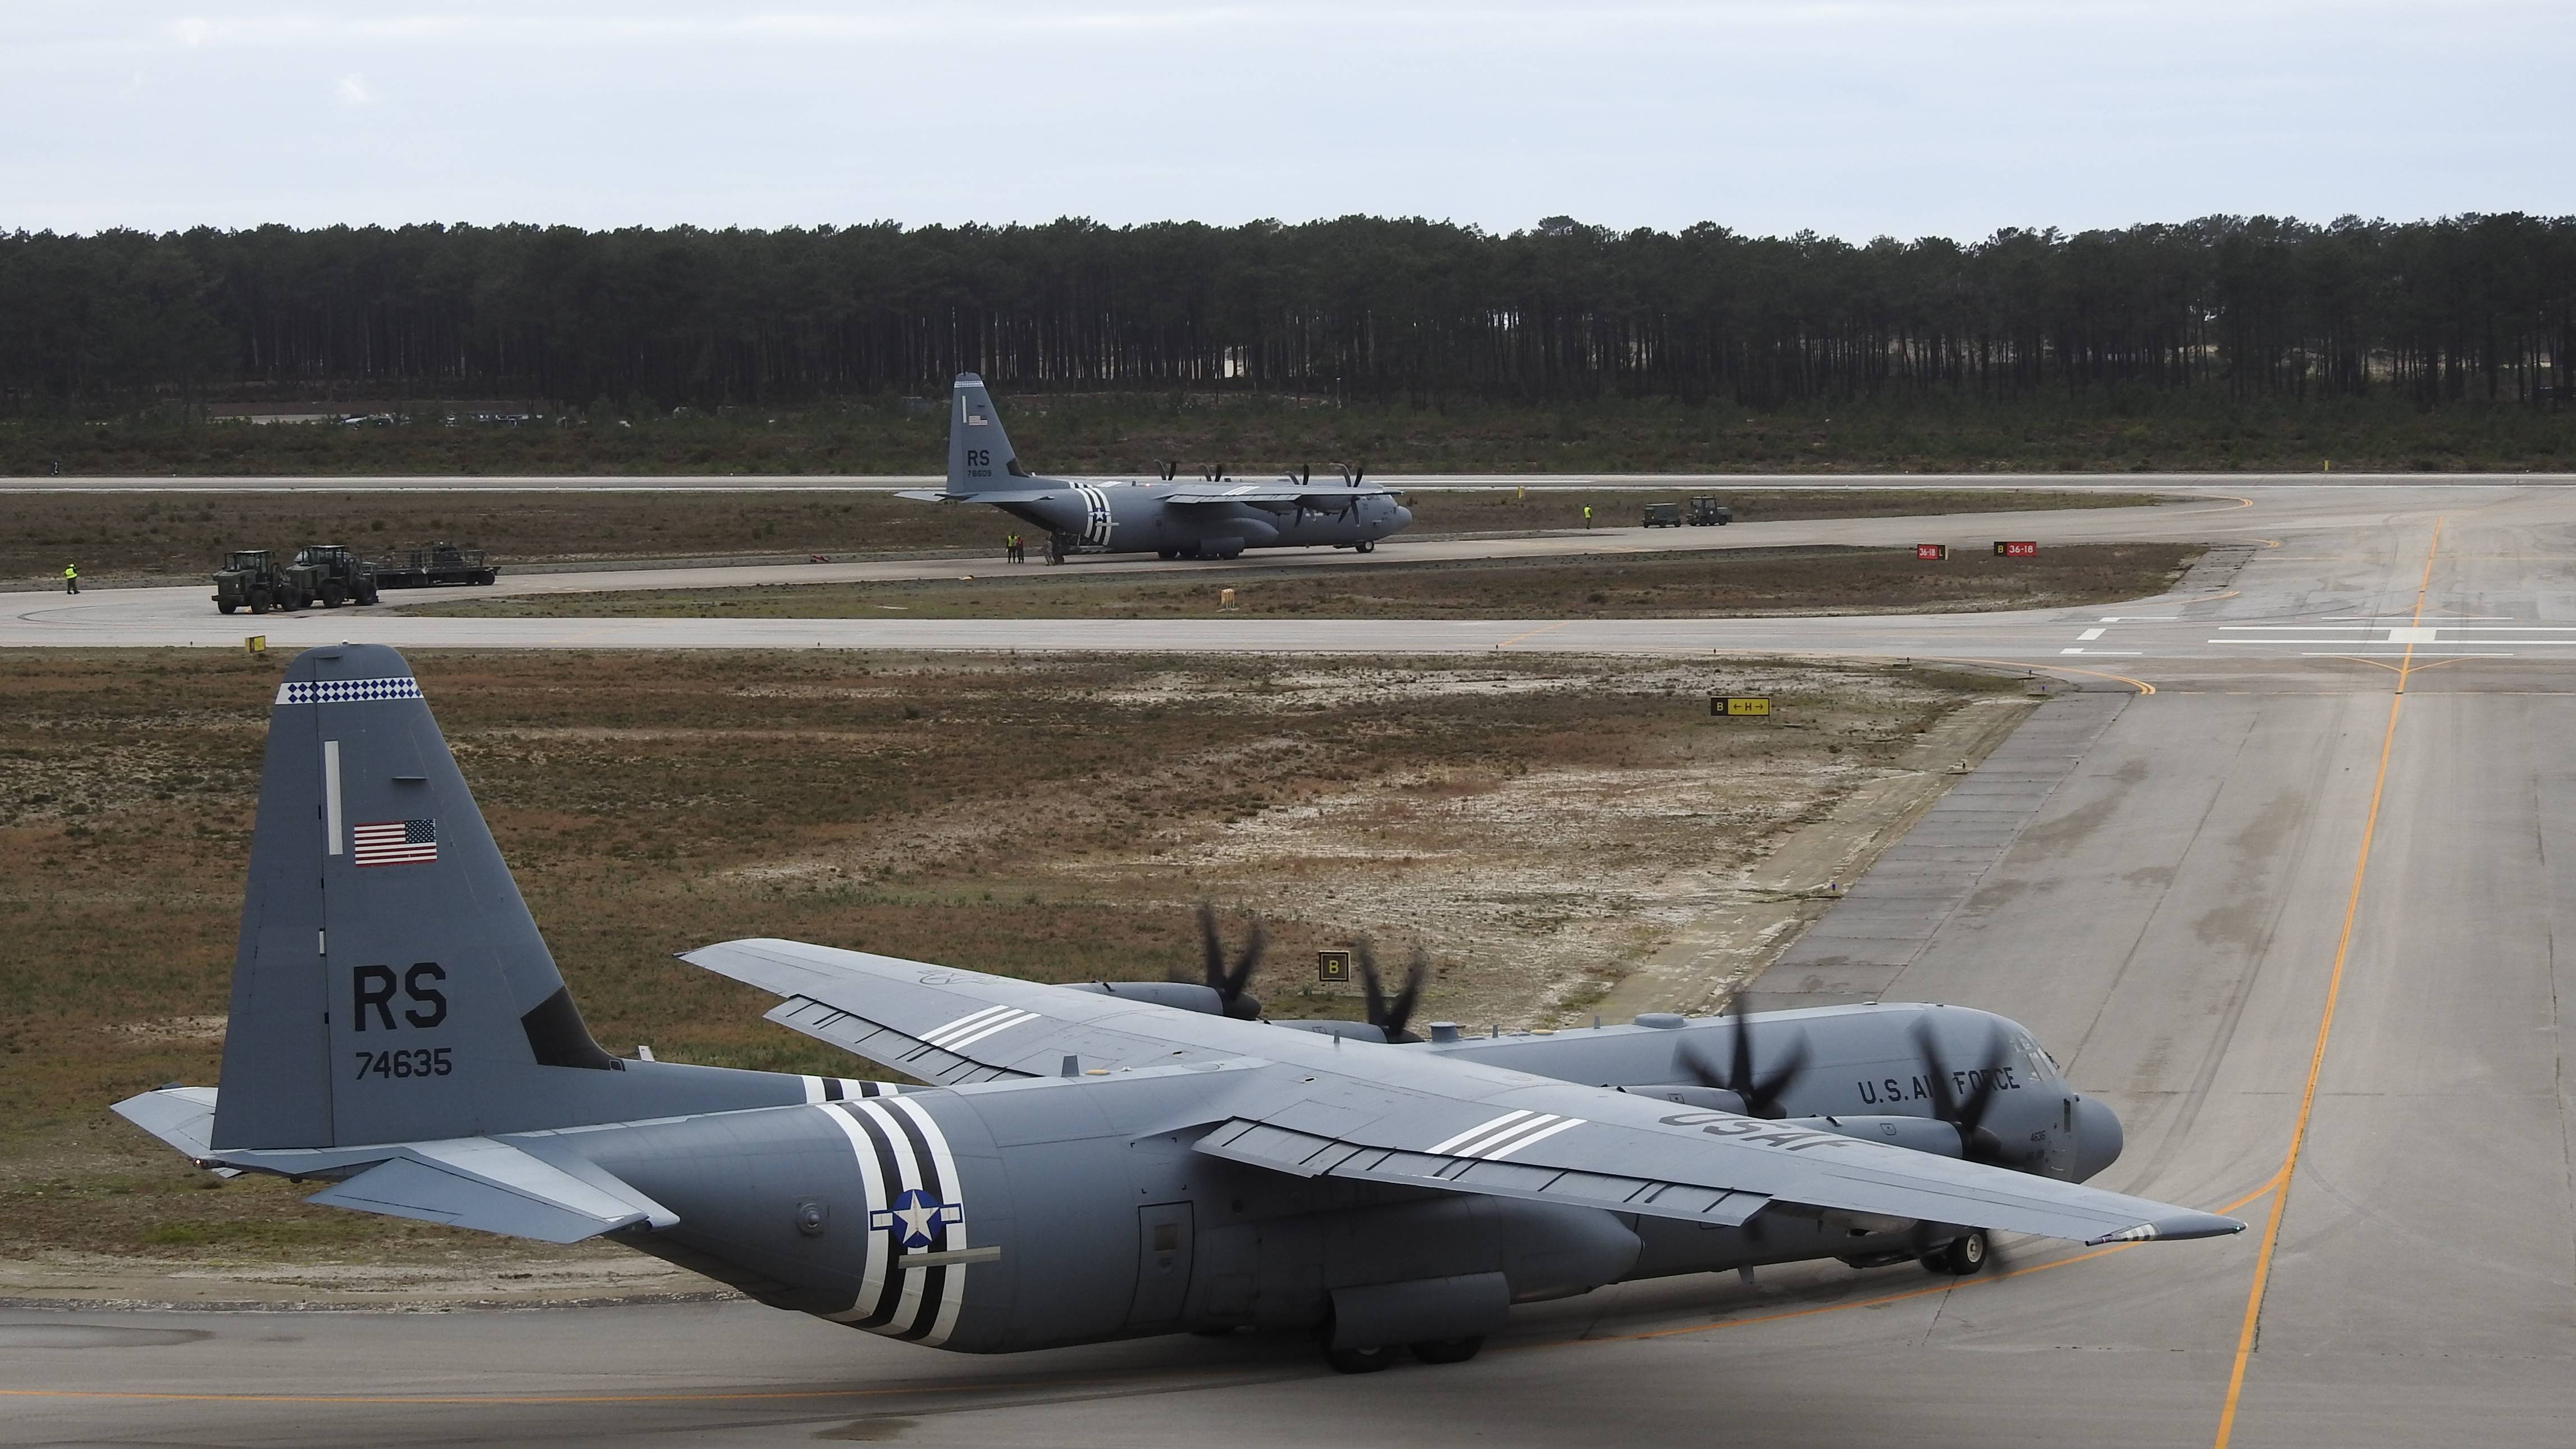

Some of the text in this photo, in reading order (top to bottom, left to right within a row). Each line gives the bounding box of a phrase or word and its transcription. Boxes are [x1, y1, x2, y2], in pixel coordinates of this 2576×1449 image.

[968, 450, 990, 466] RS
[1919, 548, 1943, 557] 36-18 L
[2009, 545, 2034, 553] 36-18
[1717, 702, 1752, 711] B H
[1329, 960, 1339, 974] B
[354, 962, 447, 1031] RS
[355, 1047, 452, 1080] 74635
[1858, 1078, 1909, 1105] U.S.
[1658, 1112, 1895, 1152] USAF
